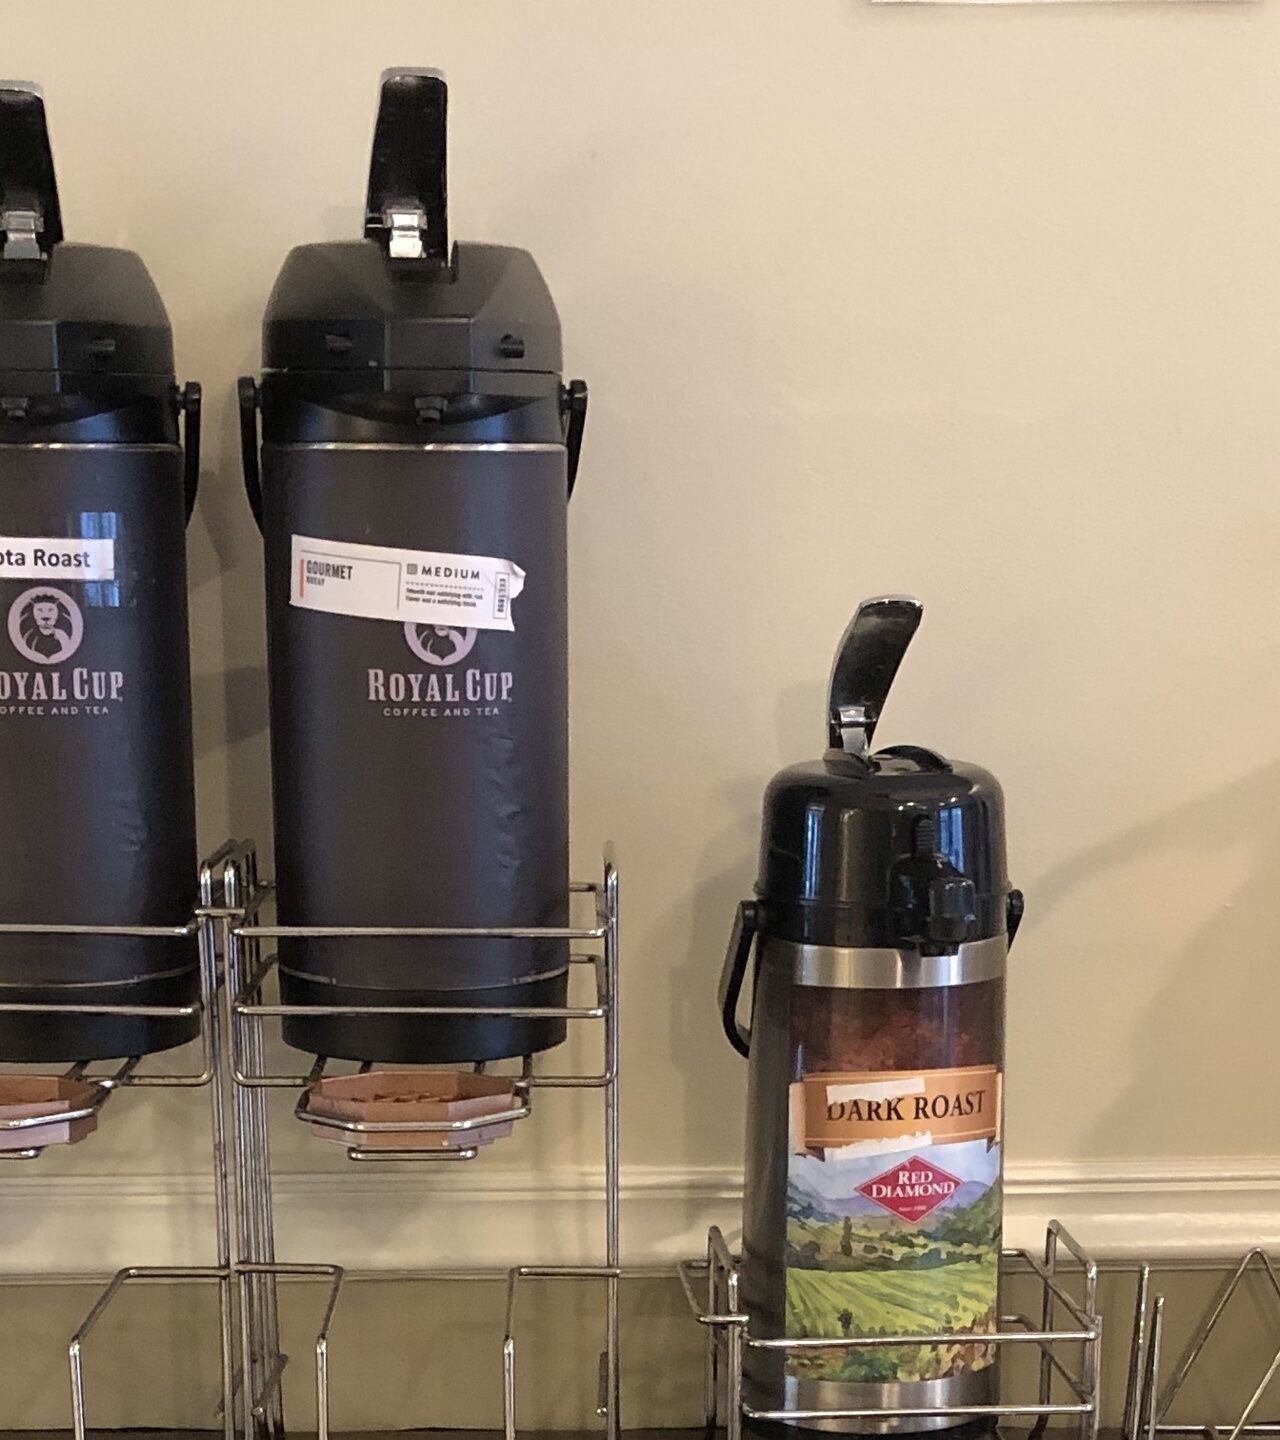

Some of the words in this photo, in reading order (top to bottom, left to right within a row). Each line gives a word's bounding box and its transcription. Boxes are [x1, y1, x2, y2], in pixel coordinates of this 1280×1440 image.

[33, 548, 91, 568] Roast
[306, 559, 354, 580] GOURMET
[421, 565, 480, 580] MEDIUM
[73, 667, 124, 701] CUP
[367, 668, 460, 701] ROYAL
[465, 668, 514, 701] CUP
[51, 705, 79, 715] AND
[85, 705, 110, 715] TEA
[383, 707, 438, 717] COFFEE
[444, 707, 471, 716] AND
[476, 707, 500, 716] TEA
[826, 1097, 905, 1122] DARK
[913, 1089, 986, 1120] ROAST
[898, 1170, 933, 1185] RED
[872, 1181, 955, 1198] DIAMOND
